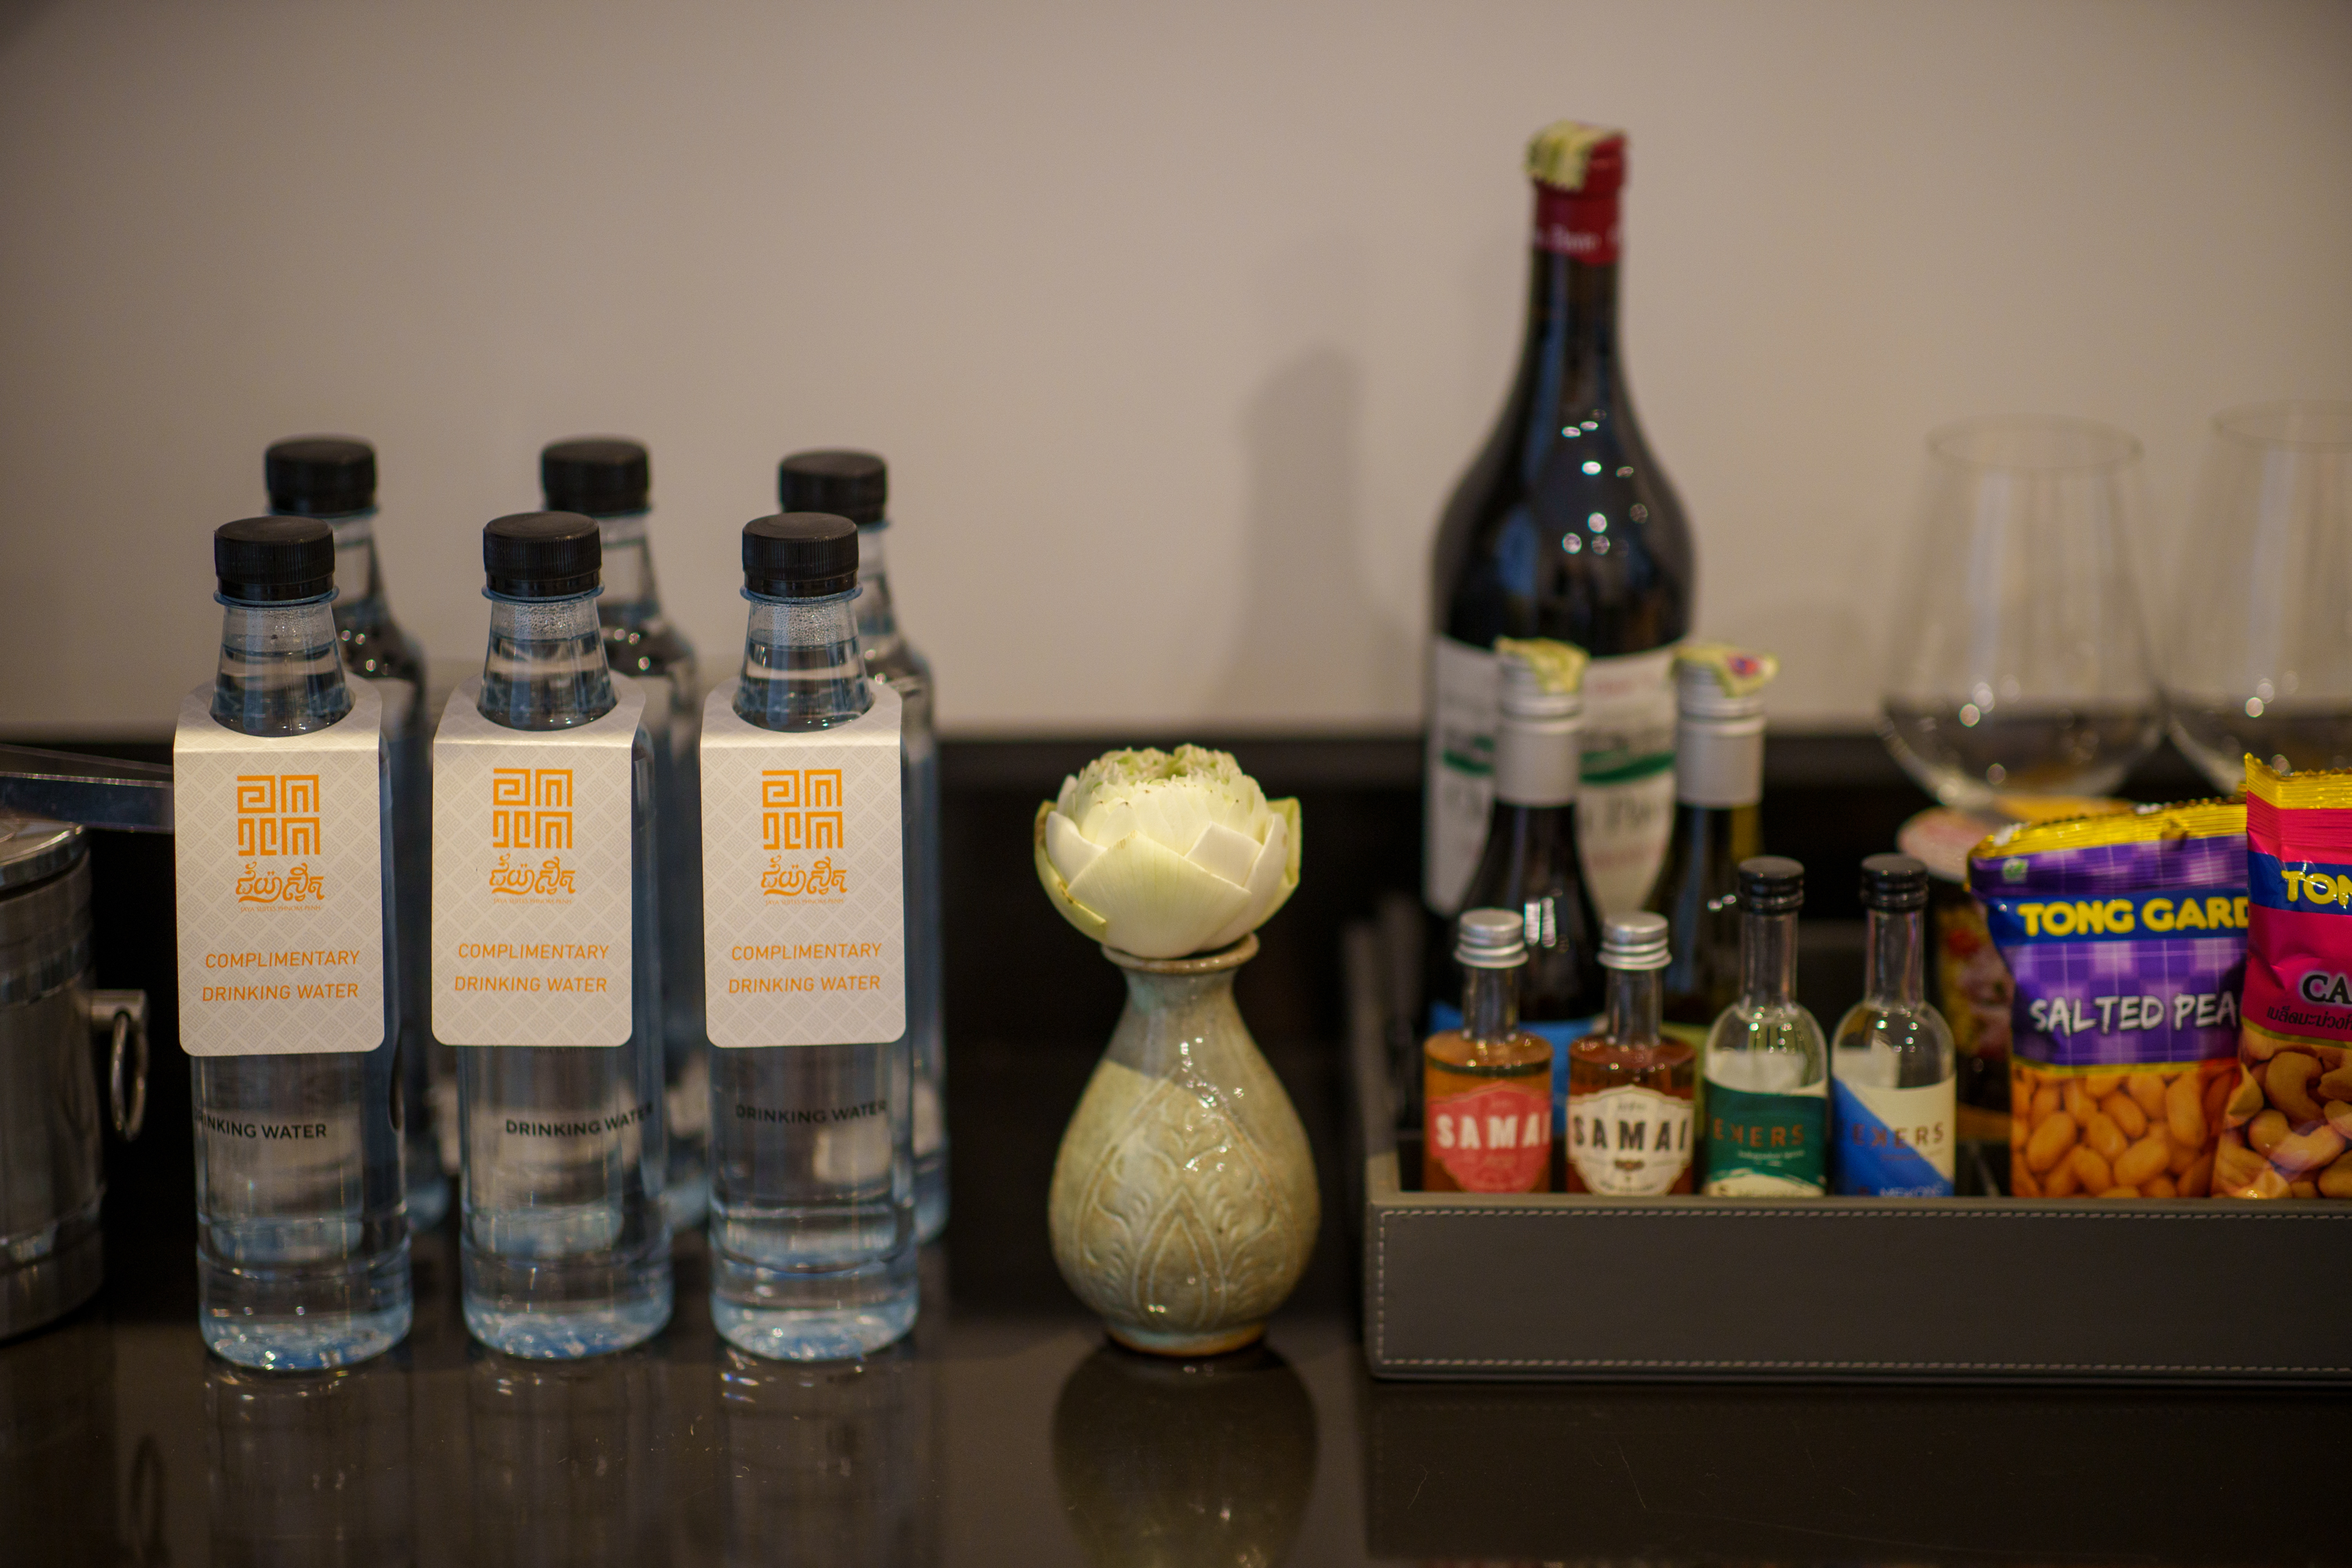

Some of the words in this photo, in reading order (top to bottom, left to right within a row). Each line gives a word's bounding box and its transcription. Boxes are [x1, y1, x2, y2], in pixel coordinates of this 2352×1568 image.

[2017, 898, 2135, 937] TONG
[205, 950, 360, 969] COMPLIMENTARY
[458, 943, 609, 960] COMPLIMENTARY
[731, 943, 882, 960] COMPLIMENTARY
[202, 985, 291, 1002] DRINKING
[297, 982, 359, 999] WATER
[455, 976, 541, 992] DRINKING
[547, 977, 608, 993] WATER
[728, 977, 815, 993] DRINKING
[820, 975, 881, 991] WATER
[2029, 996, 2165, 1036] SALTED
[2174, 990, 2239, 1031] PEA
[735, 1103, 826, 1124] DRINKING
[831, 1099, 887, 1122] WATER
[261, 1123, 327, 1140] WATER
[506, 1119, 601, 1137] DRINKING
[1573, 1114, 1689, 1151] SAMAI
